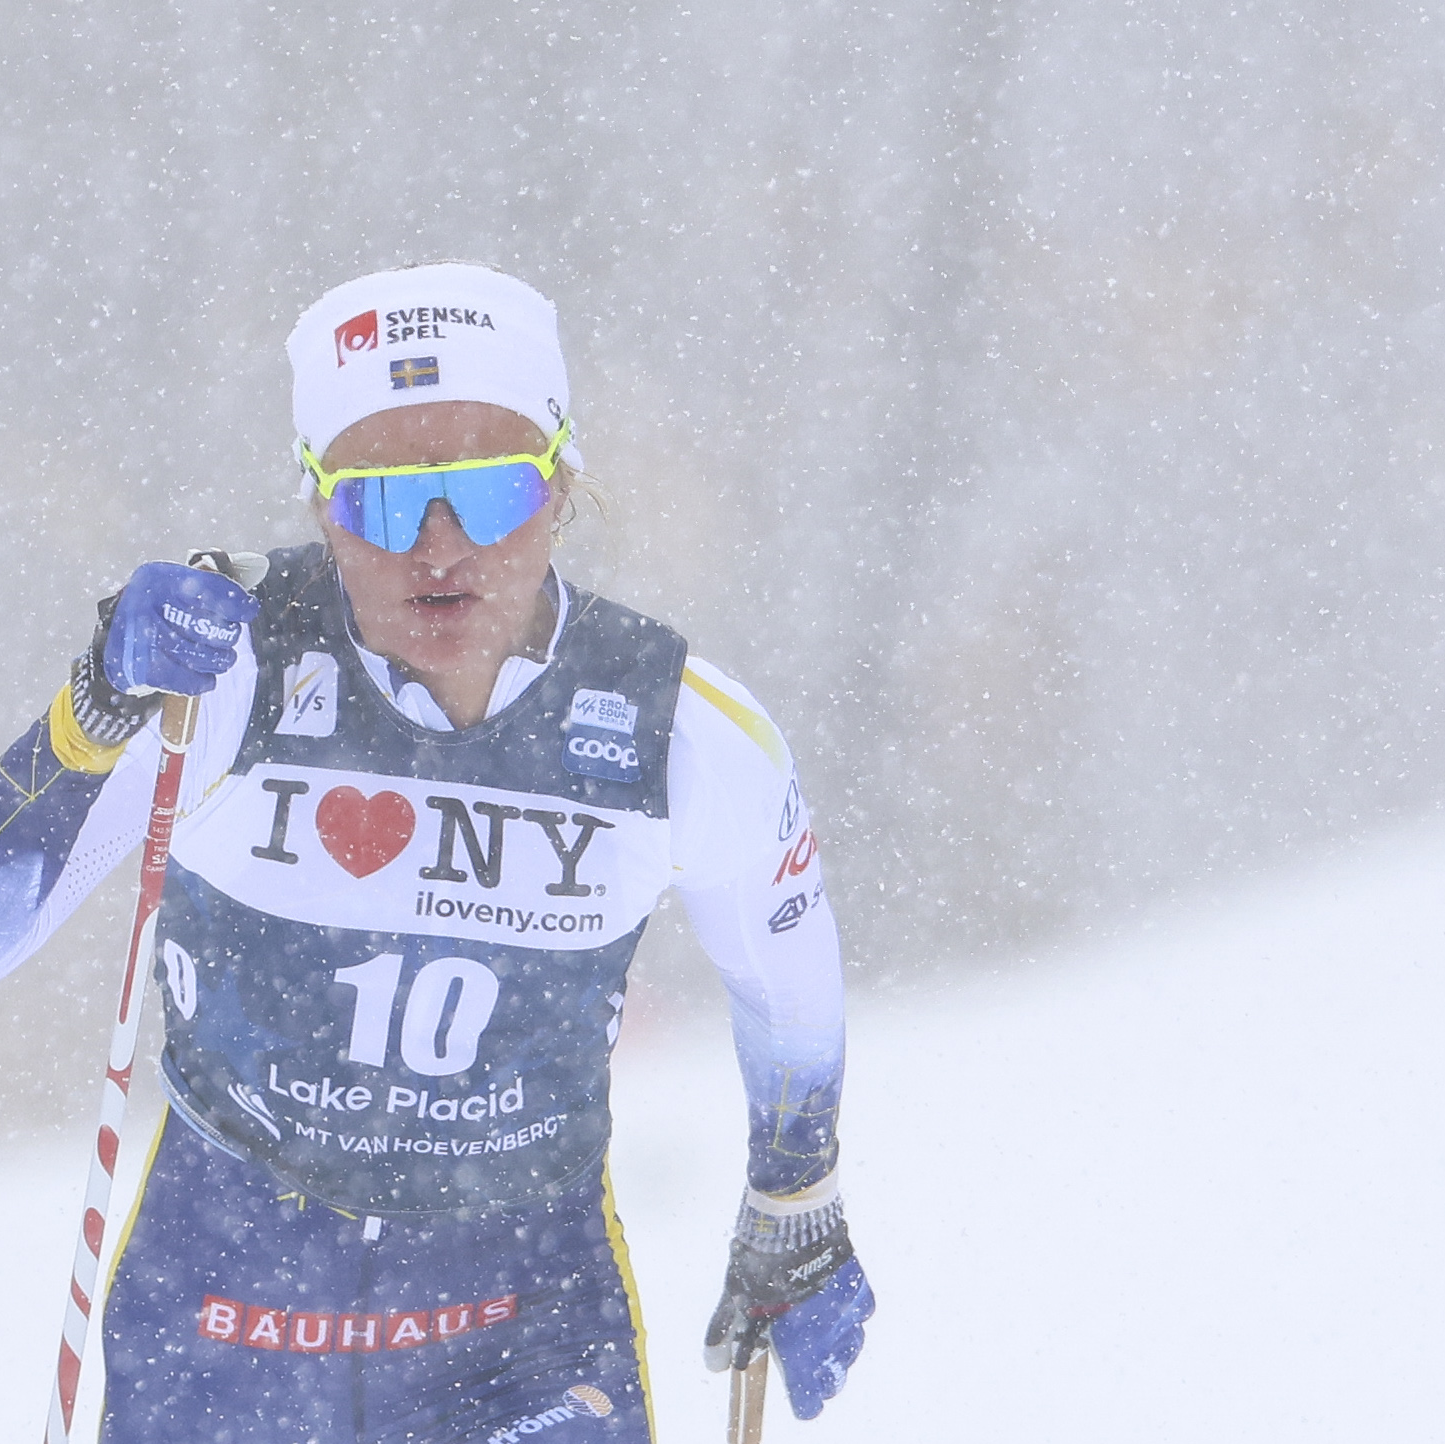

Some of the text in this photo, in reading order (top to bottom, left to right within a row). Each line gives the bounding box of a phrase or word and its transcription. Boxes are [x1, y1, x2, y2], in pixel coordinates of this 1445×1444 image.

[385, 306, 496, 331] SVENSKA
[387, 324, 447, 344] SPEL
[568, 736, 640, 770] coop
[250, 777, 616, 898] I NY
[414, 891, 604, 933] iloveny.com
[332, 952, 500, 1077] 10
[268, 1063, 524, 1121] Lake Placid
[295, 1116, 559, 1157] MT VAN HOEVENBERG
[205, 1299, 511, 1348] BAUHAUS
